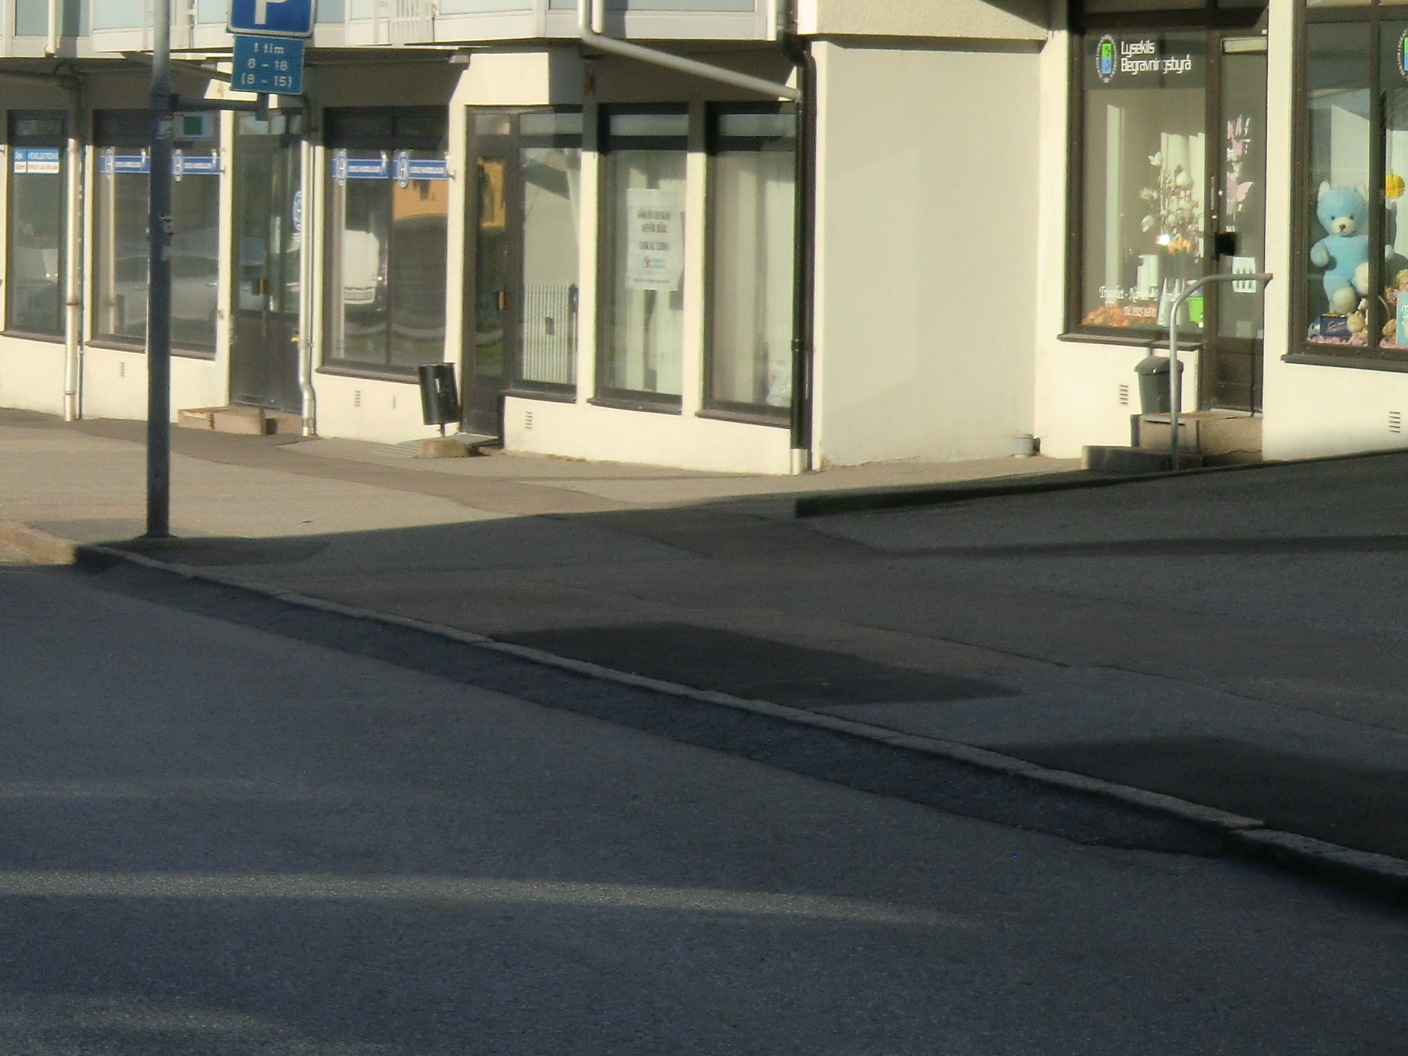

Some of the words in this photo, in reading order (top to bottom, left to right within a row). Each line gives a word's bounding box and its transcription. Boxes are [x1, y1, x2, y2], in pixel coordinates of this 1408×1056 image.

[263, 42, 285, 54] tim
[1120, 39, 1155, 58] Lysekils
[247, 58, 256, 69] 8
[274, 60, 288, 71] 18
[1120, 54, 1191, 75] Begravningsbyrå
[241, 72, 255, 86] (8
[274, 75, 293, 88] 15)
